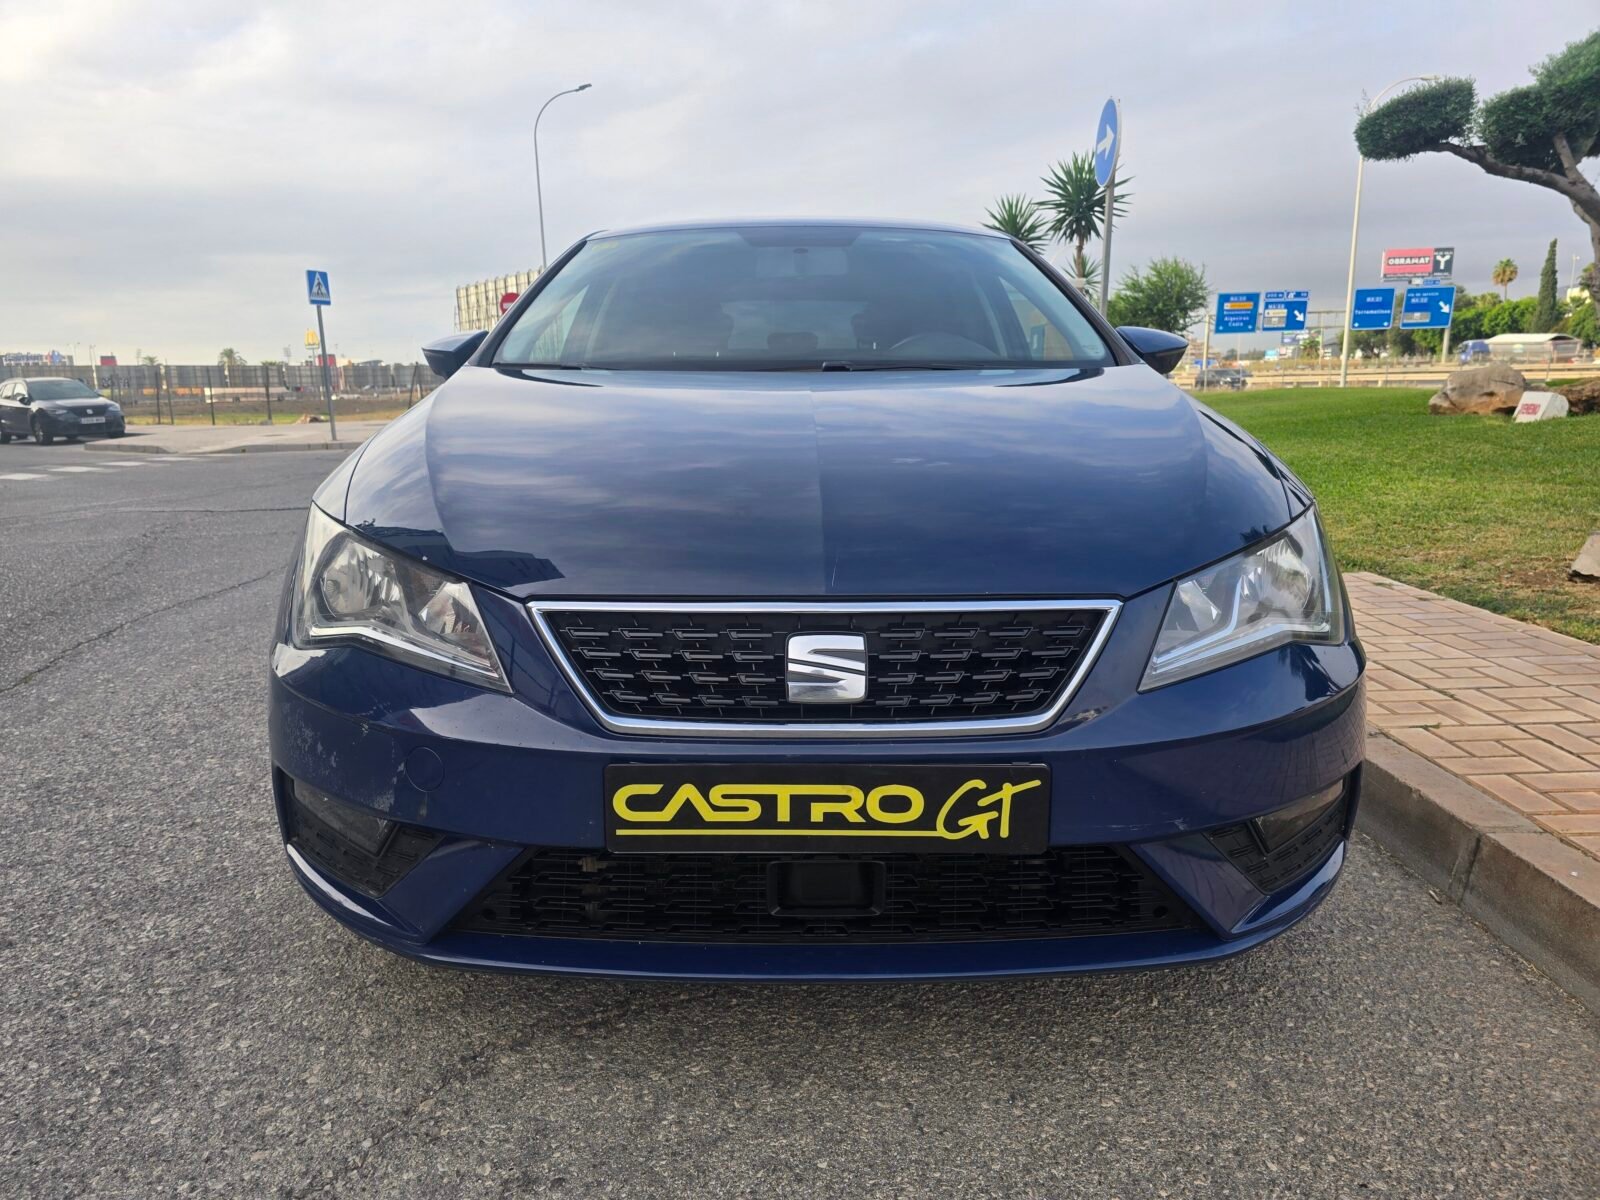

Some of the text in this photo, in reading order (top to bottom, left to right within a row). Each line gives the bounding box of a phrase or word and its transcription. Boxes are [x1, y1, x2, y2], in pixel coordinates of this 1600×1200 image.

[1388, 257, 1430, 265] OBRAMAT
[612, 778, 1042, 841] CASTRO GT
